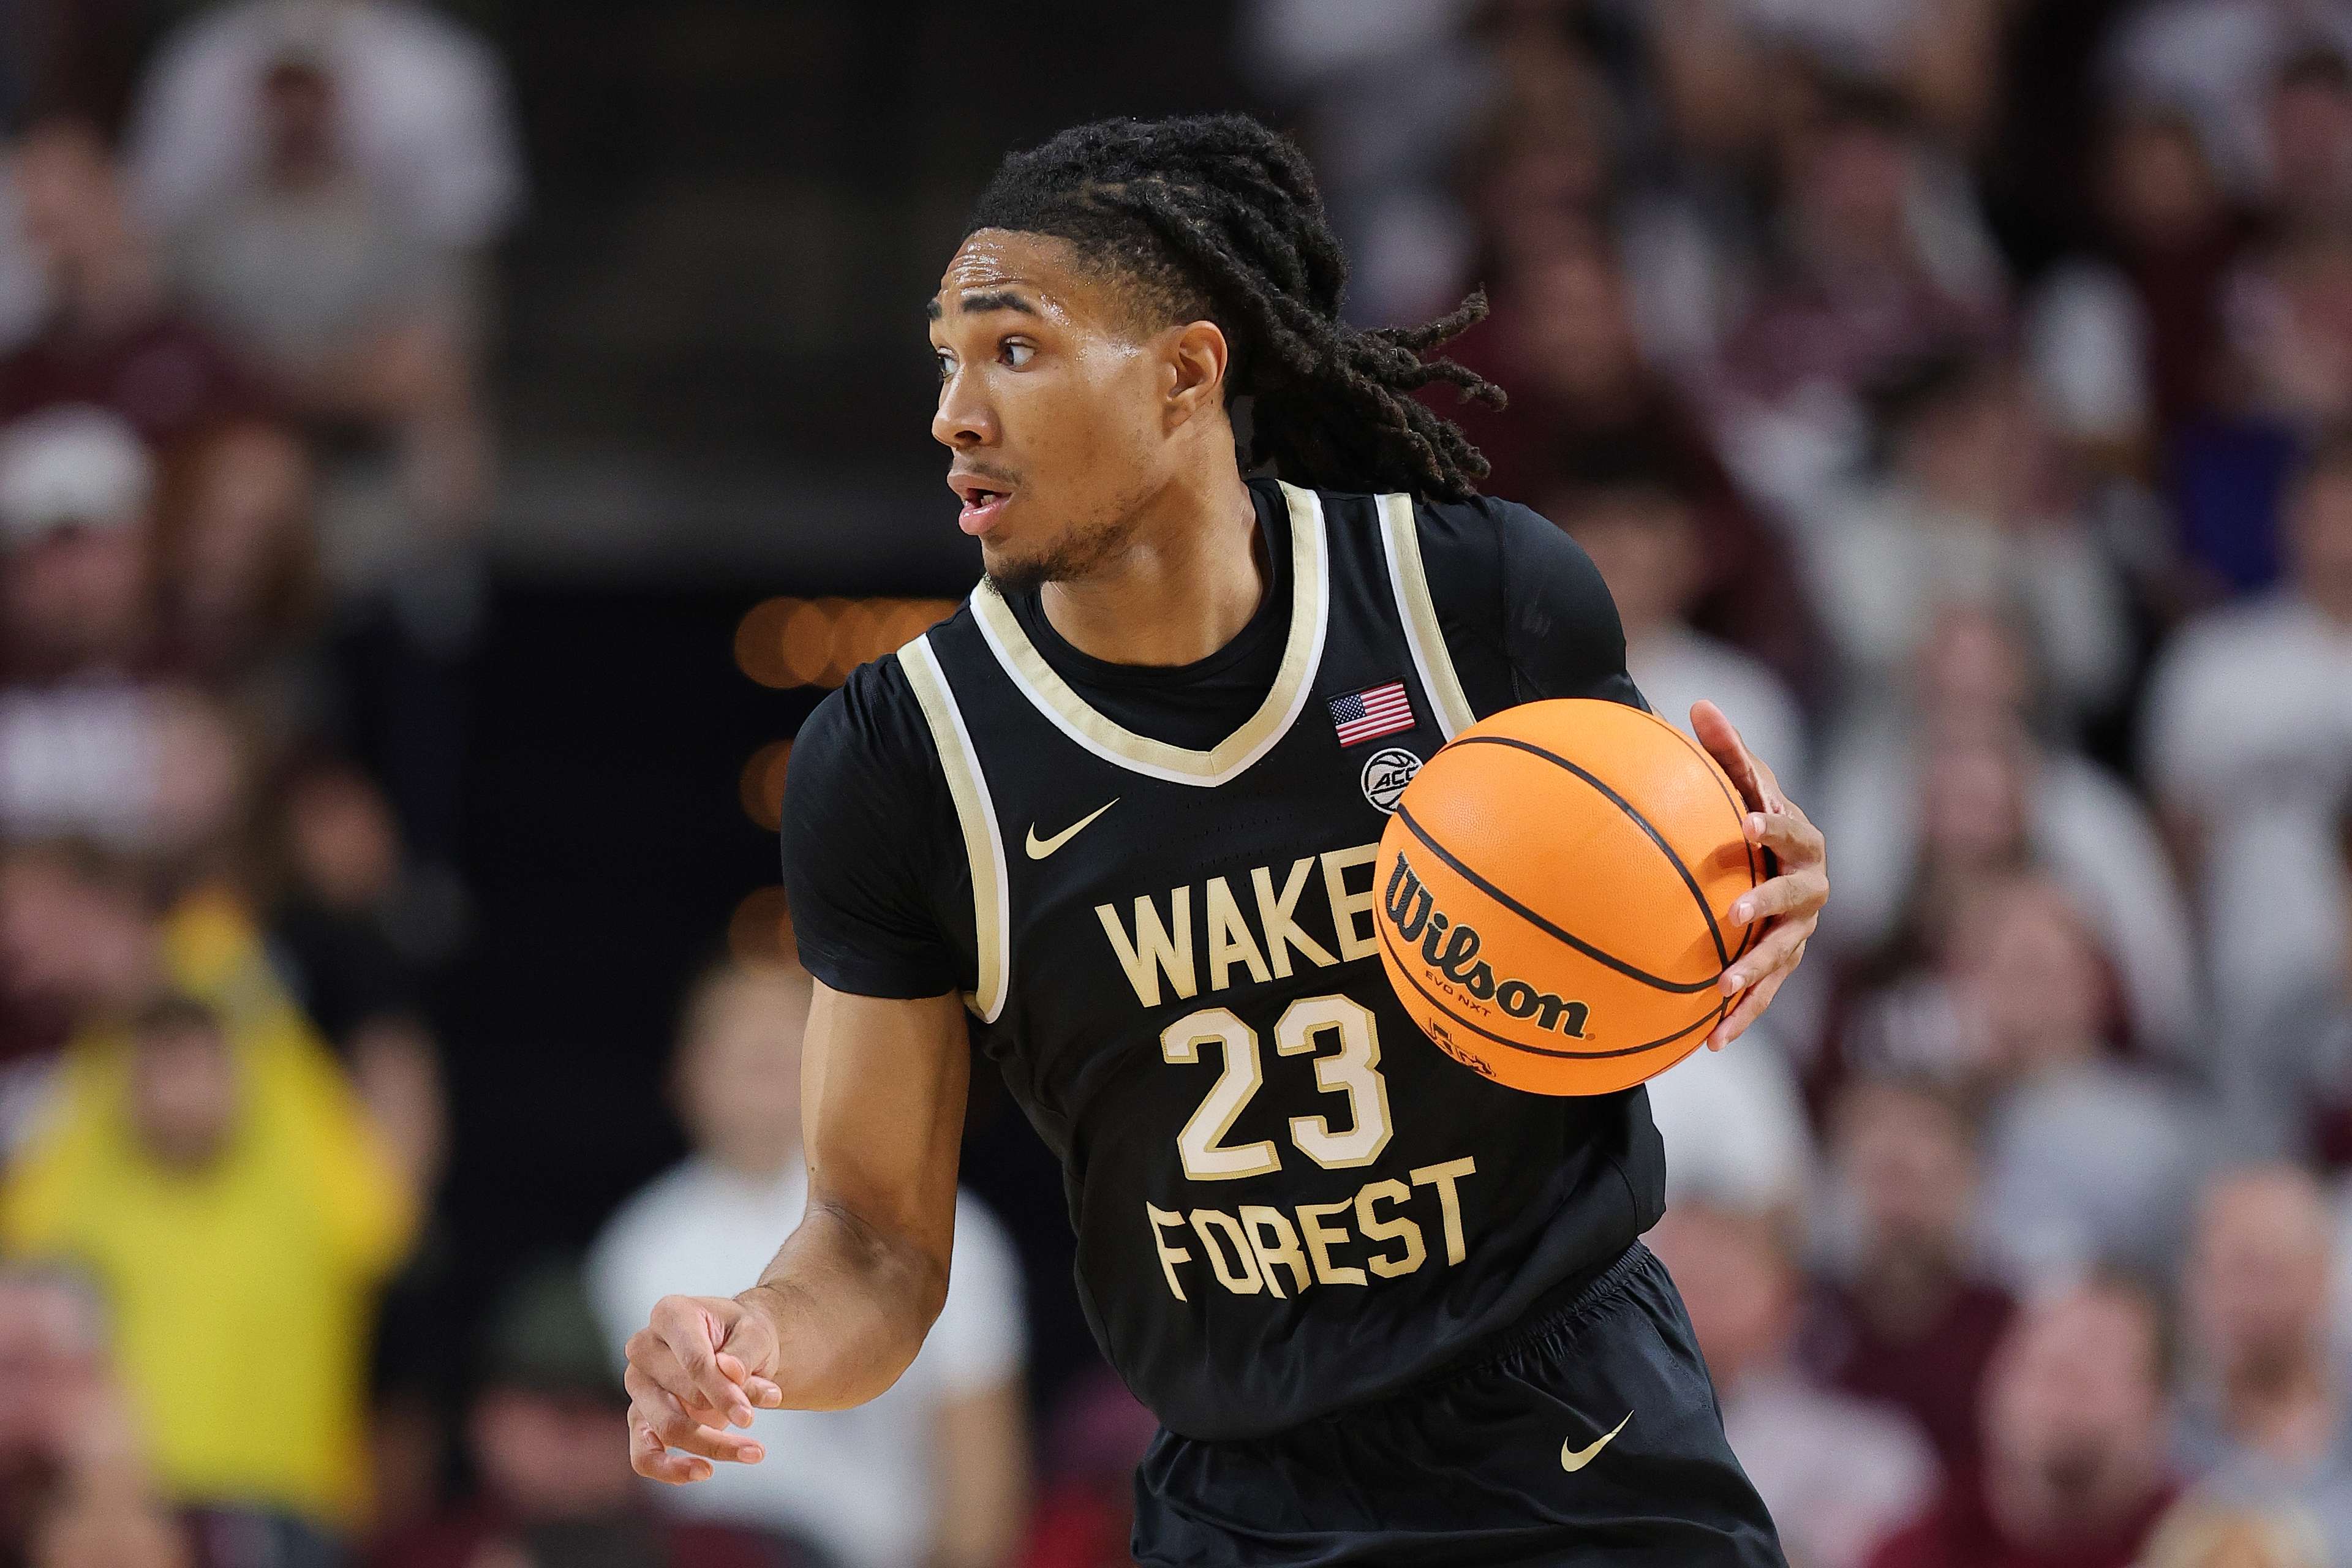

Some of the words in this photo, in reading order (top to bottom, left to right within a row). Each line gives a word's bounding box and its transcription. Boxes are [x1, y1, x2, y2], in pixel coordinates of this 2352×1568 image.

[1373, 765, 1422, 790] ACC
[1095, 842, 1379, 1008] WAKE
[1385, 848, 1591, 1040] Wilson
[1425, 970, 1453, 995] EVO
[1458, 994, 1492, 1017] NXT
[1159, 993, 1393, 1181] 23
[1145, 1156, 1477, 1303] FOREST
